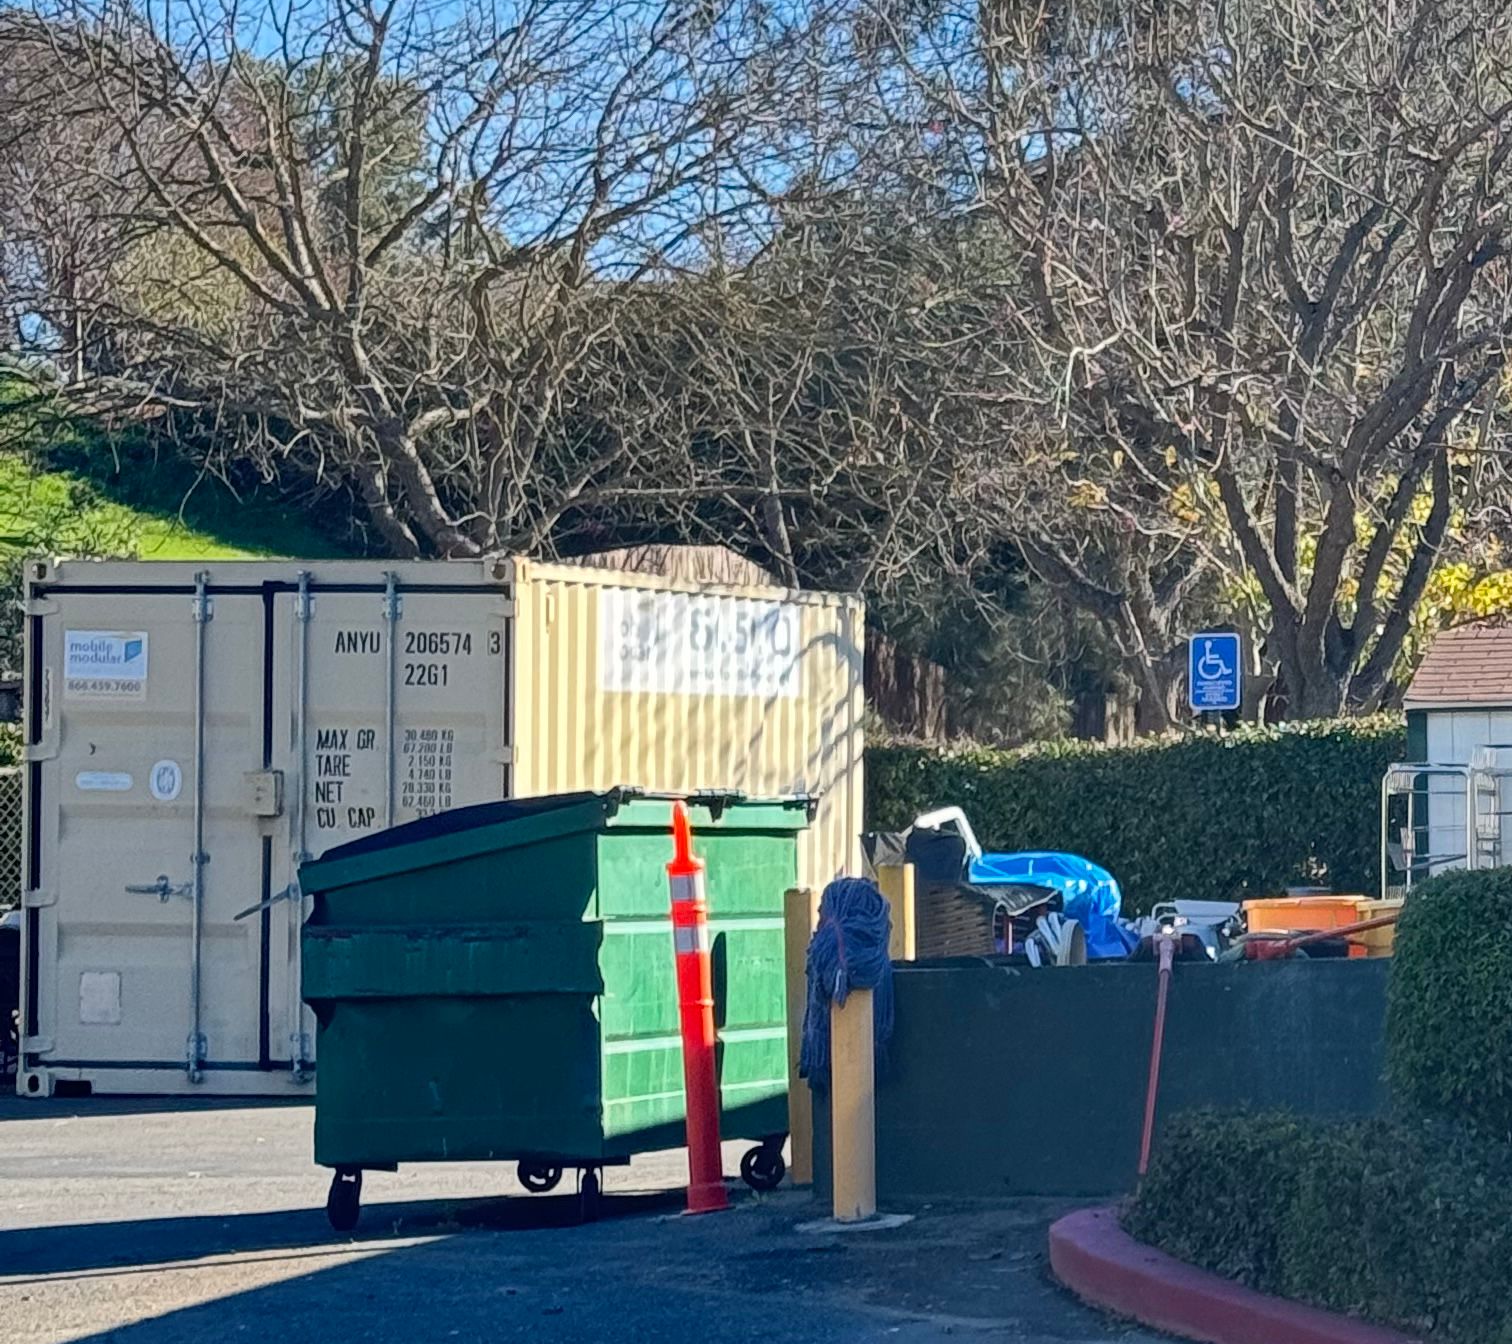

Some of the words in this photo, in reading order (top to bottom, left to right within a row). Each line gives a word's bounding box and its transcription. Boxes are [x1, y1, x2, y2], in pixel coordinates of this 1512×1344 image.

[70, 640, 113, 653] mobile
[335, 631, 381, 654] ANYU
[405, 631, 472, 655] 206574
[490, 632, 501, 655] 3
[69, 651, 122, 665] modular
[404, 663, 448, 687] 22G1
[315, 754, 352, 777] TARE
[315, 780, 344, 804] NET
